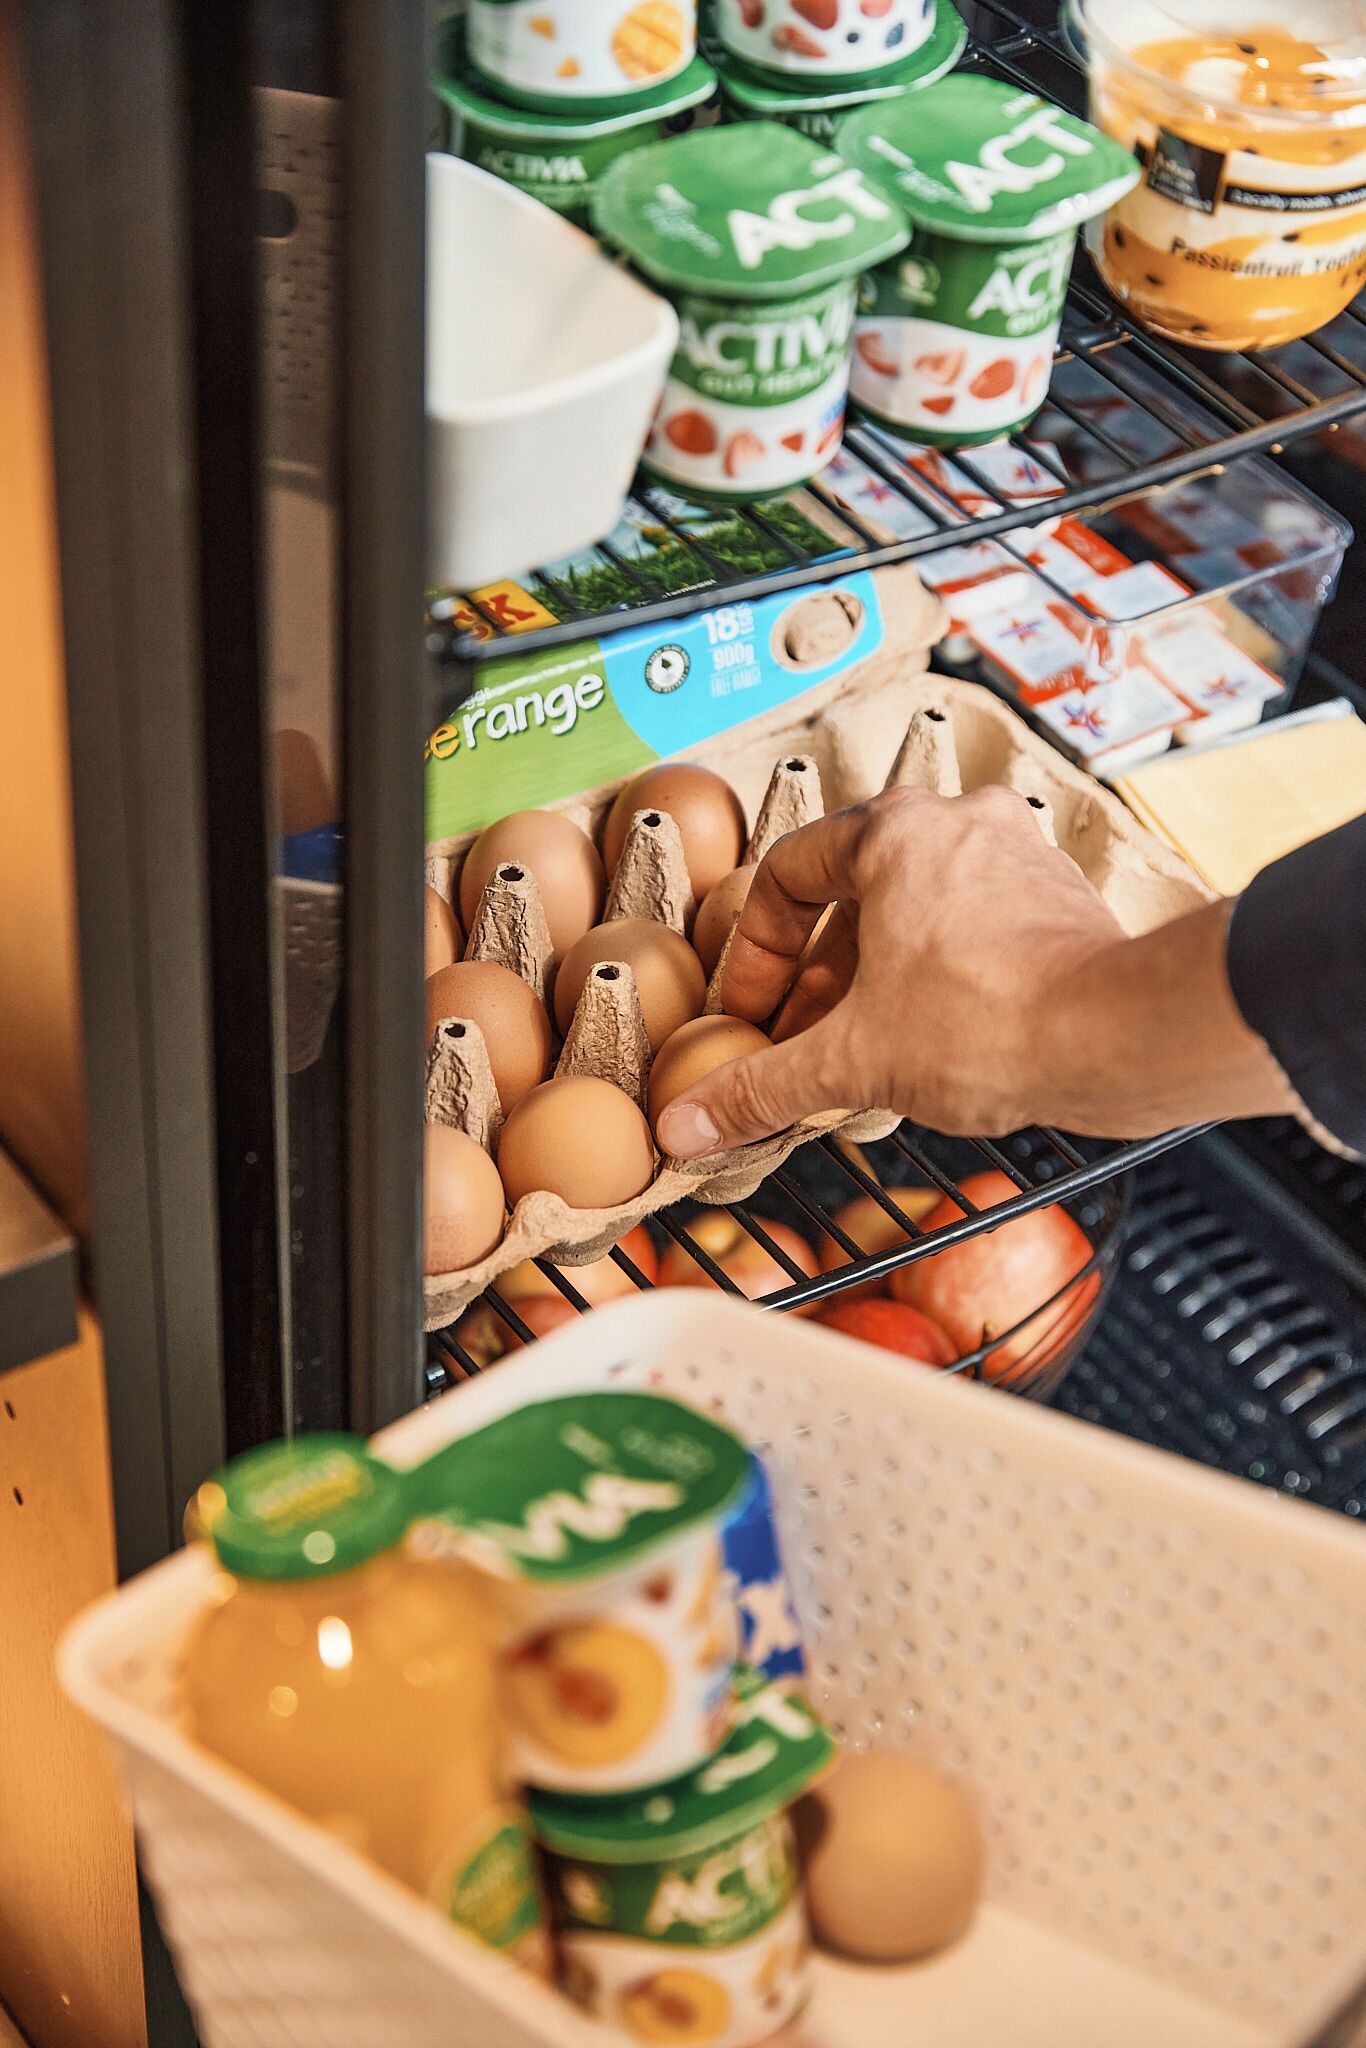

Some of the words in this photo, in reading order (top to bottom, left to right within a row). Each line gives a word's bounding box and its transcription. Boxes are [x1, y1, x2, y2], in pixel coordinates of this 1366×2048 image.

[944, 108, 1095, 214] ACT
[728, 168, 893, 270] ACT
[700, 607, 740, 645] 18
